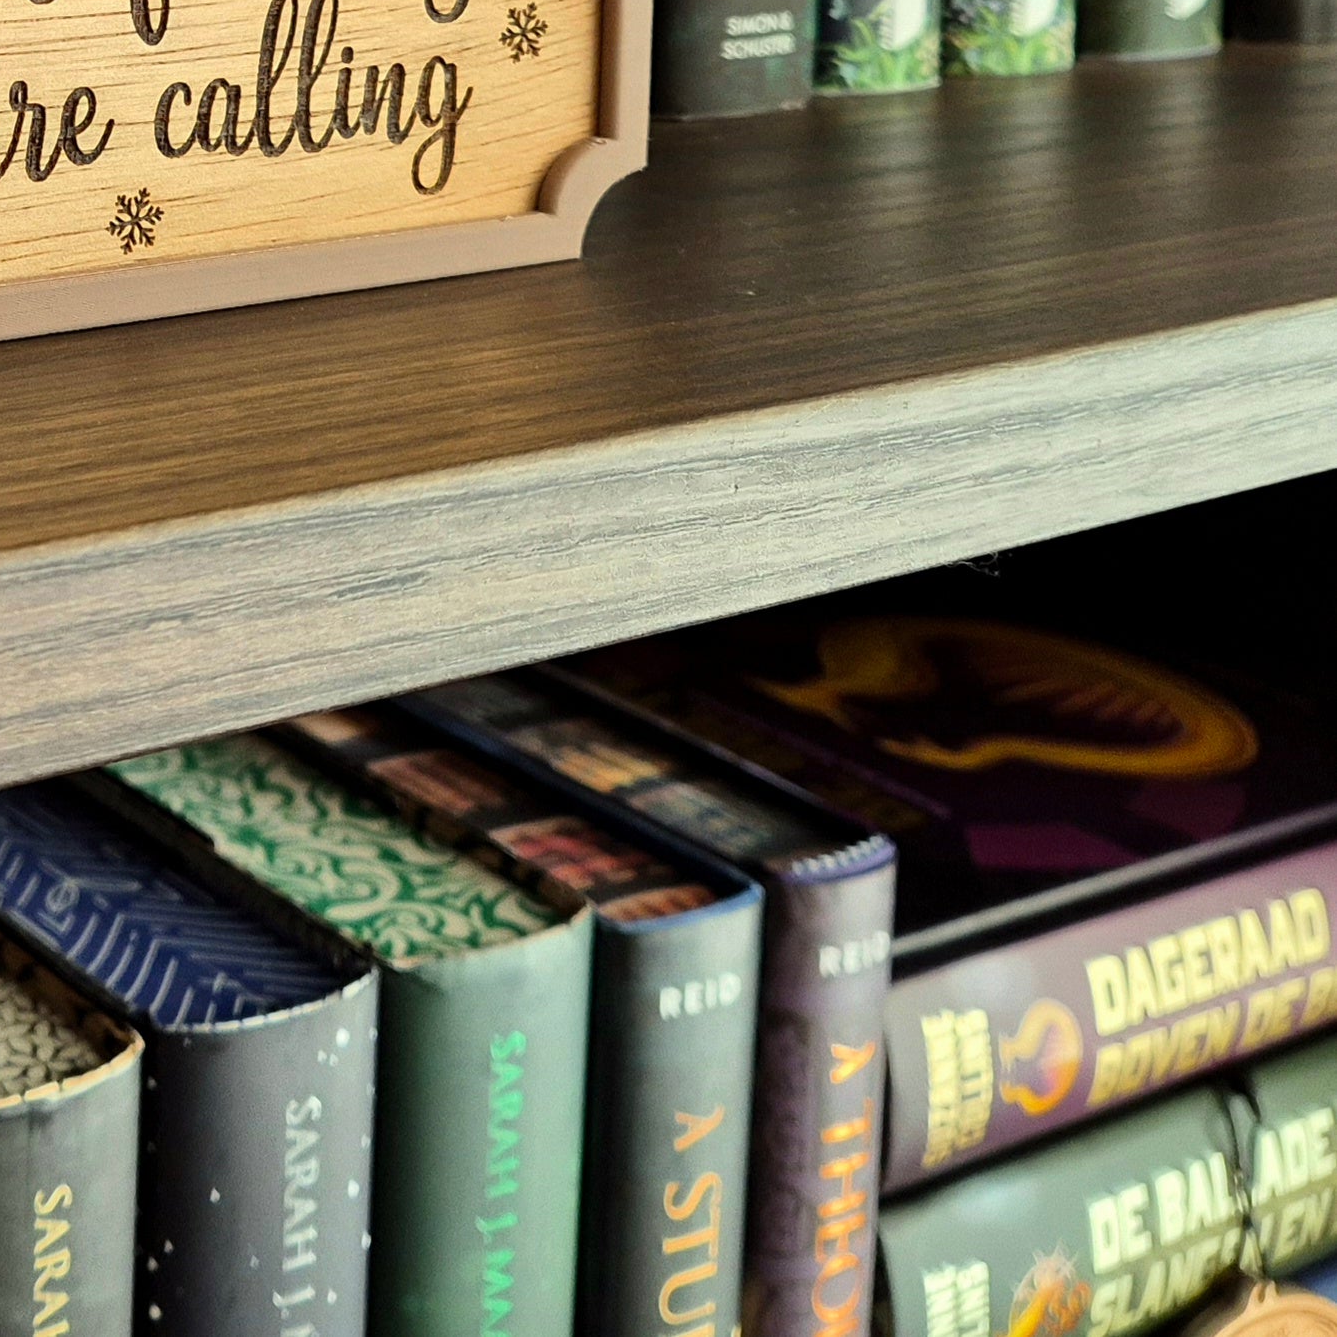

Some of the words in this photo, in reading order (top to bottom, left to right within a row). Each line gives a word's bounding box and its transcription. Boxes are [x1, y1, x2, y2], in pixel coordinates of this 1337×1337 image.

[658, 971, 742, 1021] REID
[819, 930, 891, 979] REID
[1086, 886, 1332, 1037] DAGERAAD
[829, 1041, 876, 1085] A
[1085, 1000, 1241, 1108] BOVEN
[1239, 976, 1307, 1051] DE
[484, 1029, 528, 1200] SARAH
[673, 1104, 726, 1152] A
[281, 1096, 325, 1274] SARAH
[1087, 1181, 1154, 1276] DE
[658, 1171, 723, 1337] STU
